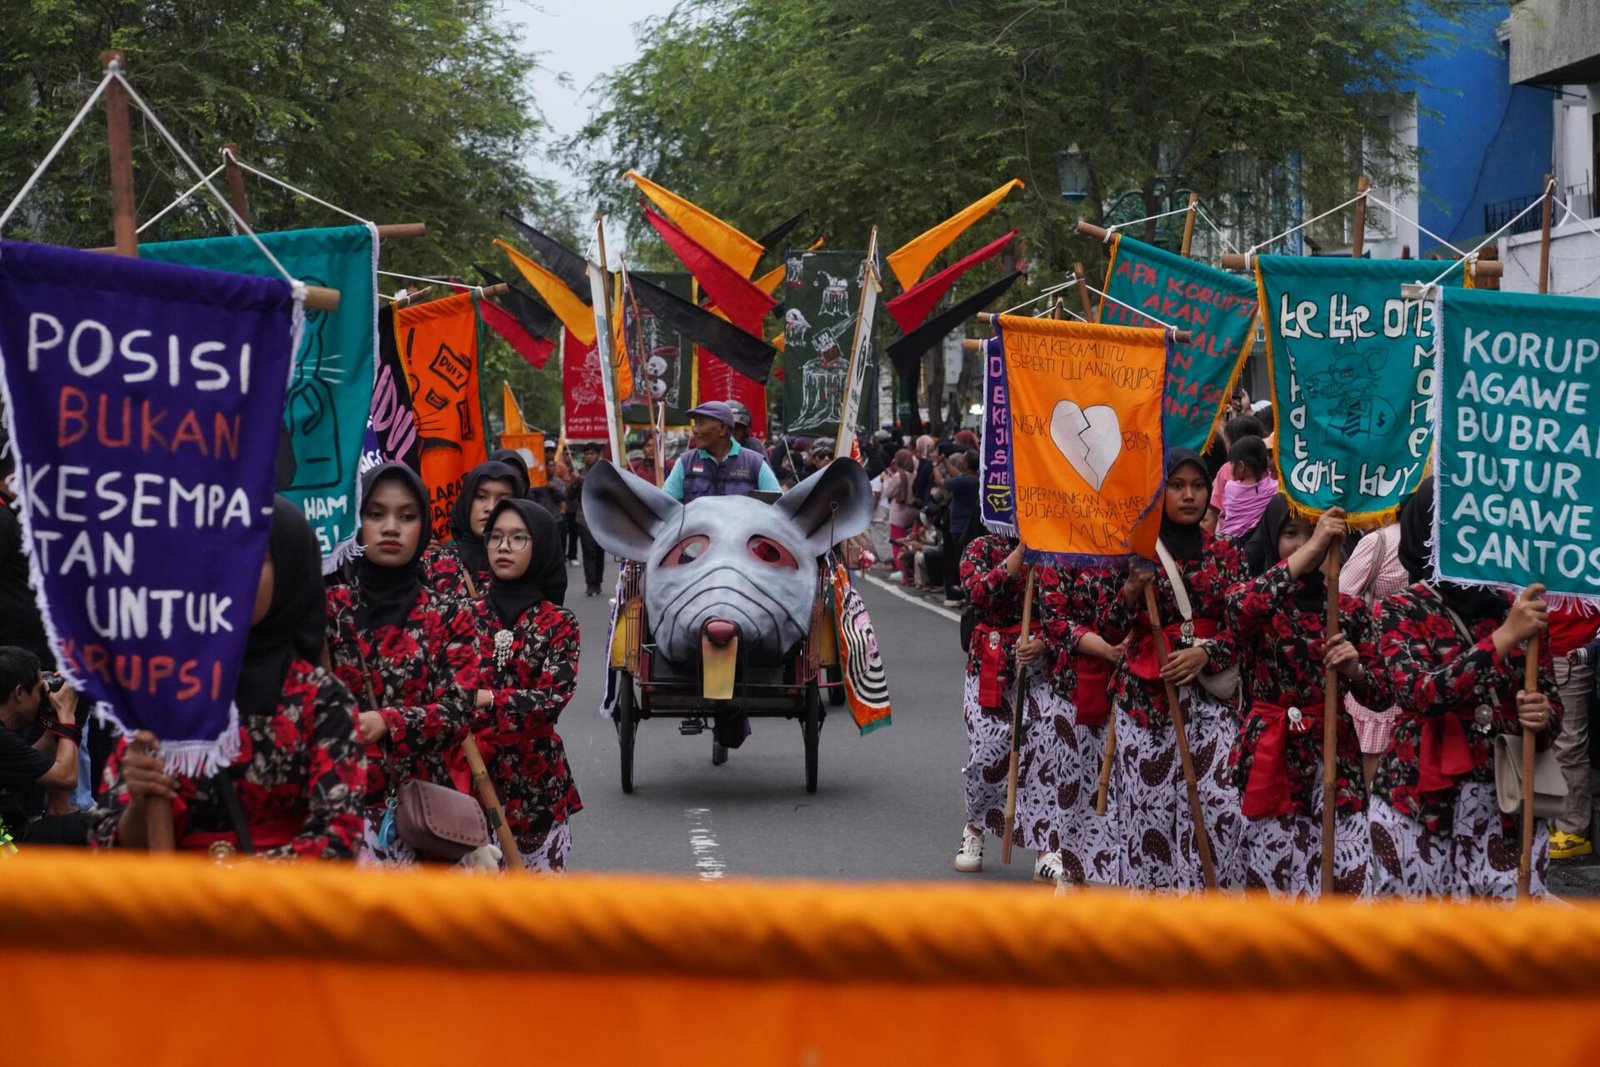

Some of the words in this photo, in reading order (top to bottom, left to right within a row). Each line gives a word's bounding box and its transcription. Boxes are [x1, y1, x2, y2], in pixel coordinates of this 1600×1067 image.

[1115, 259, 1157, 287] APA
[1142, 293, 1210, 326] AKAN
[27, 312, 251, 395] POSISI
[439, 355, 464, 380] DUIT
[1010, 352, 1055, 373] SEPERTI
[1463, 327, 1599, 374] KORUP
[1457, 369, 1590, 415] AGAWE
[57, 385, 241, 461] BUKAN
[1457, 406, 1600, 459] BUBRA
[1451, 451, 1582, 501] JUJUR
[1452, 492, 1593, 541] AGAWE
[34, 530, 134, 576] TAN
[1452, 526, 1600, 586] SANTOS
[86, 586, 234, 640] UNTUK
